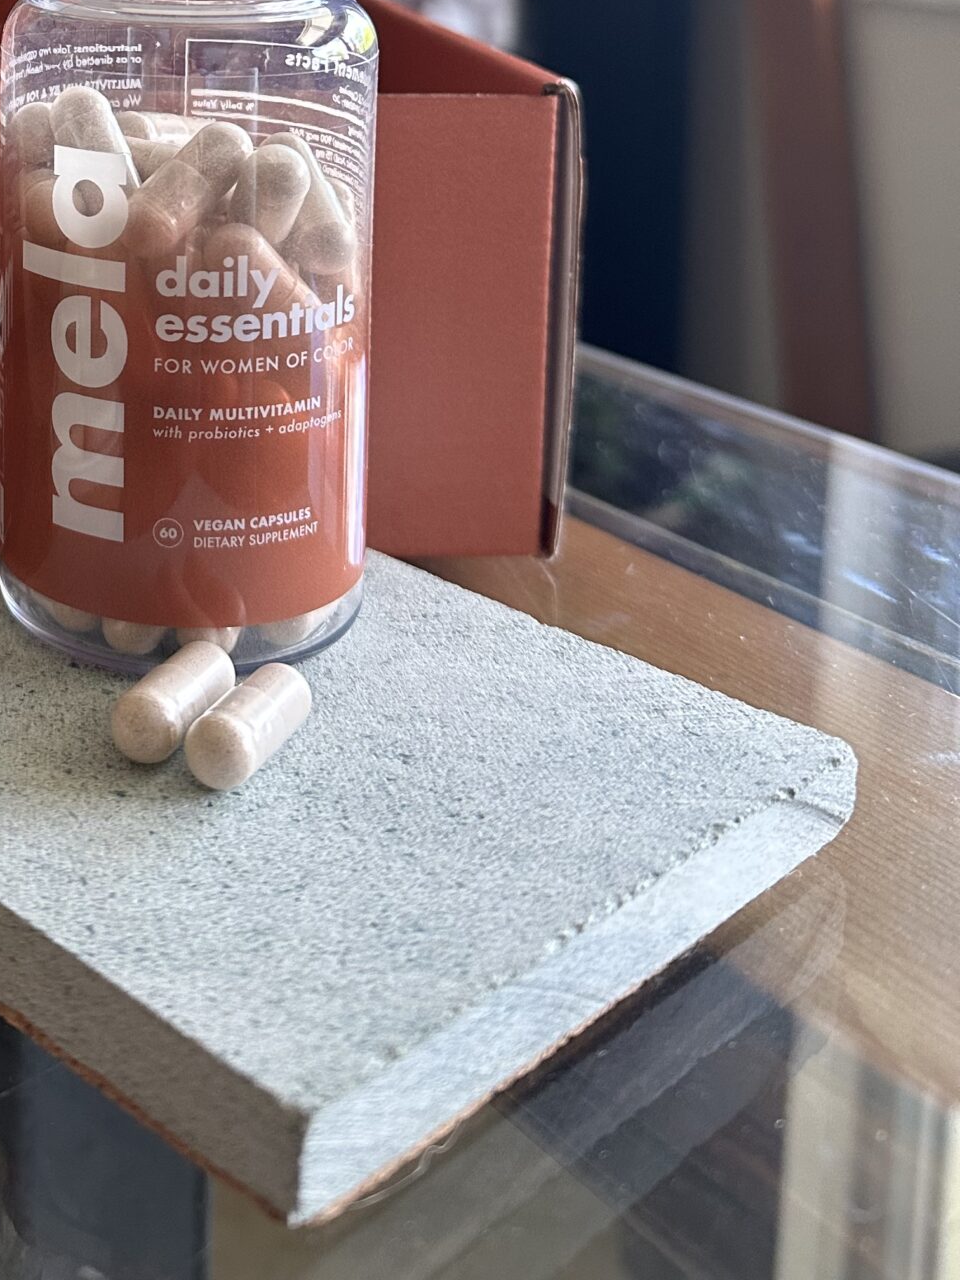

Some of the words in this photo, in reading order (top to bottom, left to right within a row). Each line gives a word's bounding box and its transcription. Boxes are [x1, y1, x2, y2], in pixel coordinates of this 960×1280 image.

[155, 255, 281, 309] daily
[155, 284, 356, 344] essentials
[23, 145, 128, 542] mela
[154, 358, 192, 374] FOR
[201, 356, 279, 375] WOMEN
[286, 351, 308, 368] OF
[153, 406, 203, 421] DAILY
[209, 396, 321, 421] MULTIVITAMIN
[153, 425, 182, 439] with
[188, 426, 260, 443] probiotics
[265, 424, 274, 434] +
[278, 409, 342, 435] adaptogens
[159, 527, 177, 539] 60
[193, 519, 246, 531] VEGAN
[250, 507, 311, 529] CAPSULES
[193, 535, 245, 549] DIETARY
[249, 521, 319, 546] SUPPLEMENT
